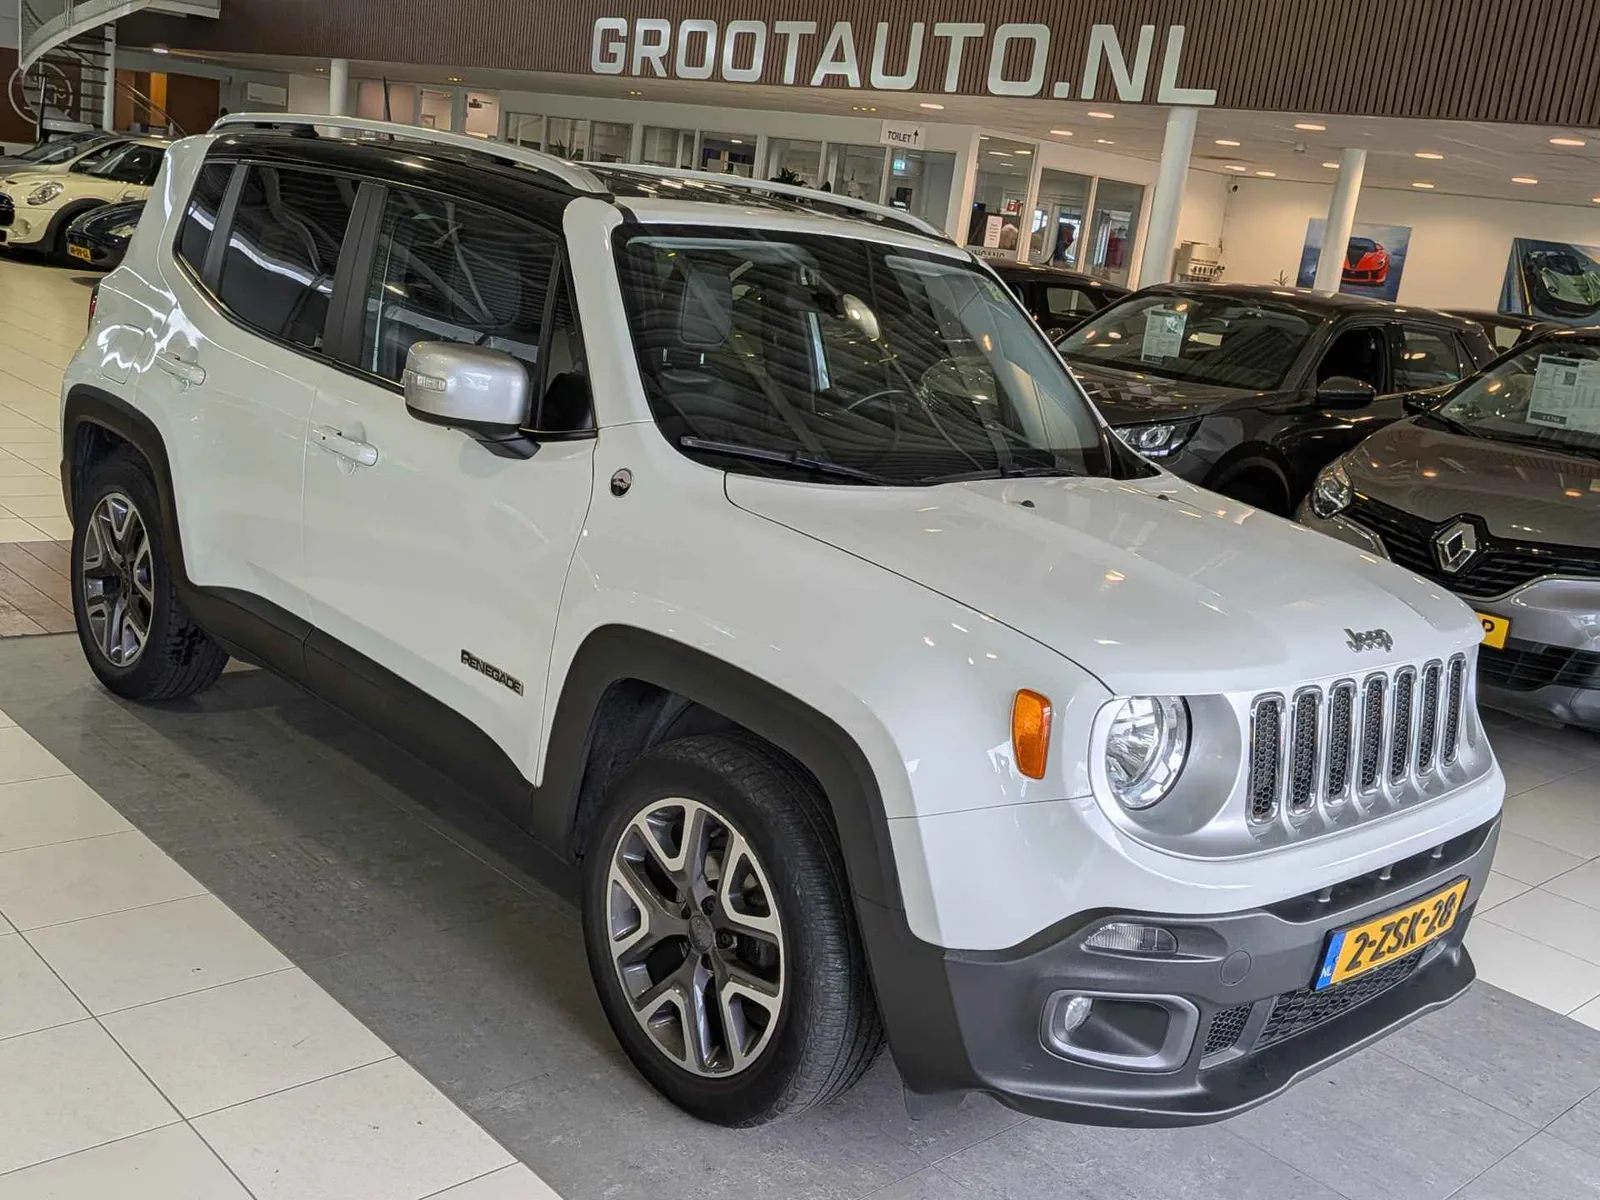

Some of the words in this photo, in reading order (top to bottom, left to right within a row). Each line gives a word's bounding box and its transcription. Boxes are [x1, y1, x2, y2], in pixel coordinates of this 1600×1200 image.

[591, 17, 1218, 106] GROOTAUTO.NL
[887, 130, 912, 143] TOILET
[1343, 628, 1394, 653] Jeep
[461, 648, 524, 697] RENEGADE
[1344, 891, 1458, 973] 2-ZSK-28
[1320, 966, 1332, 978] NL
